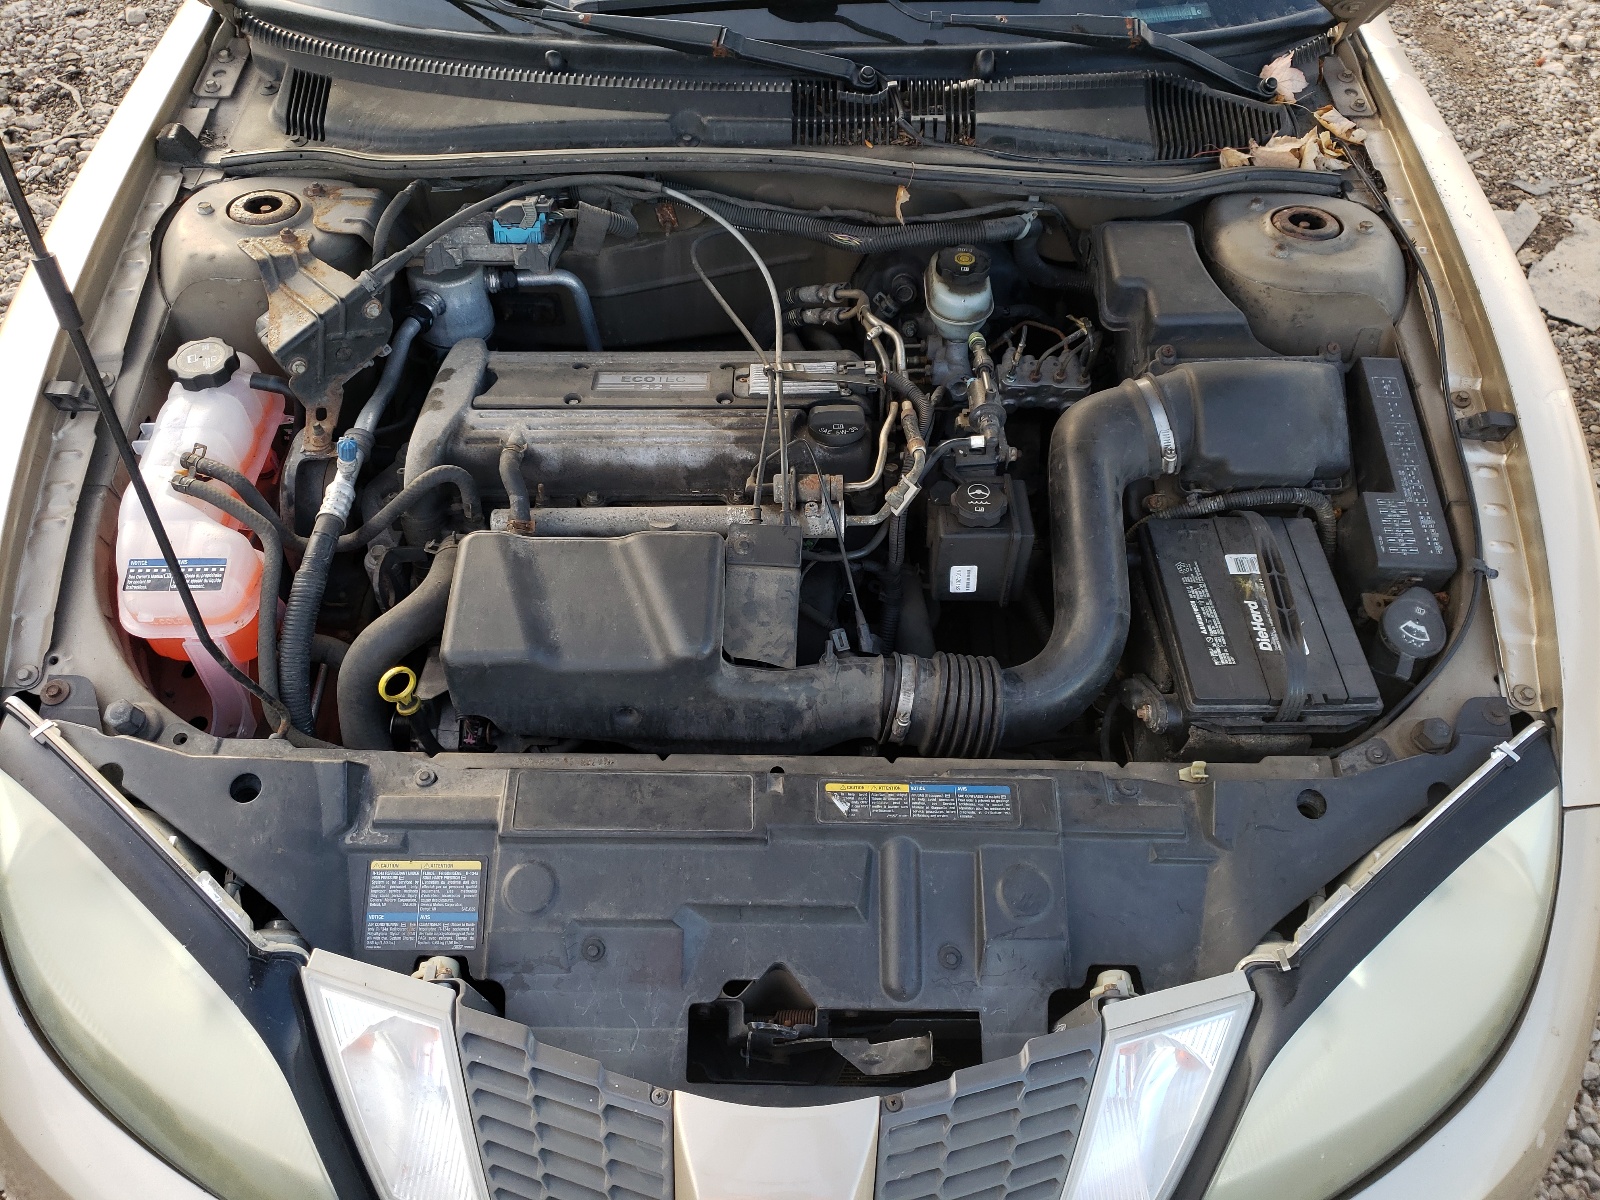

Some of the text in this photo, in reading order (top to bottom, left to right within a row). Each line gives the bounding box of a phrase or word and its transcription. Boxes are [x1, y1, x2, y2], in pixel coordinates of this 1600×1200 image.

[620, 375, 686, 383] ECOTEC
[818, 427, 833, 435] SAE
[1243, 600, 1274, 652] DieHard
